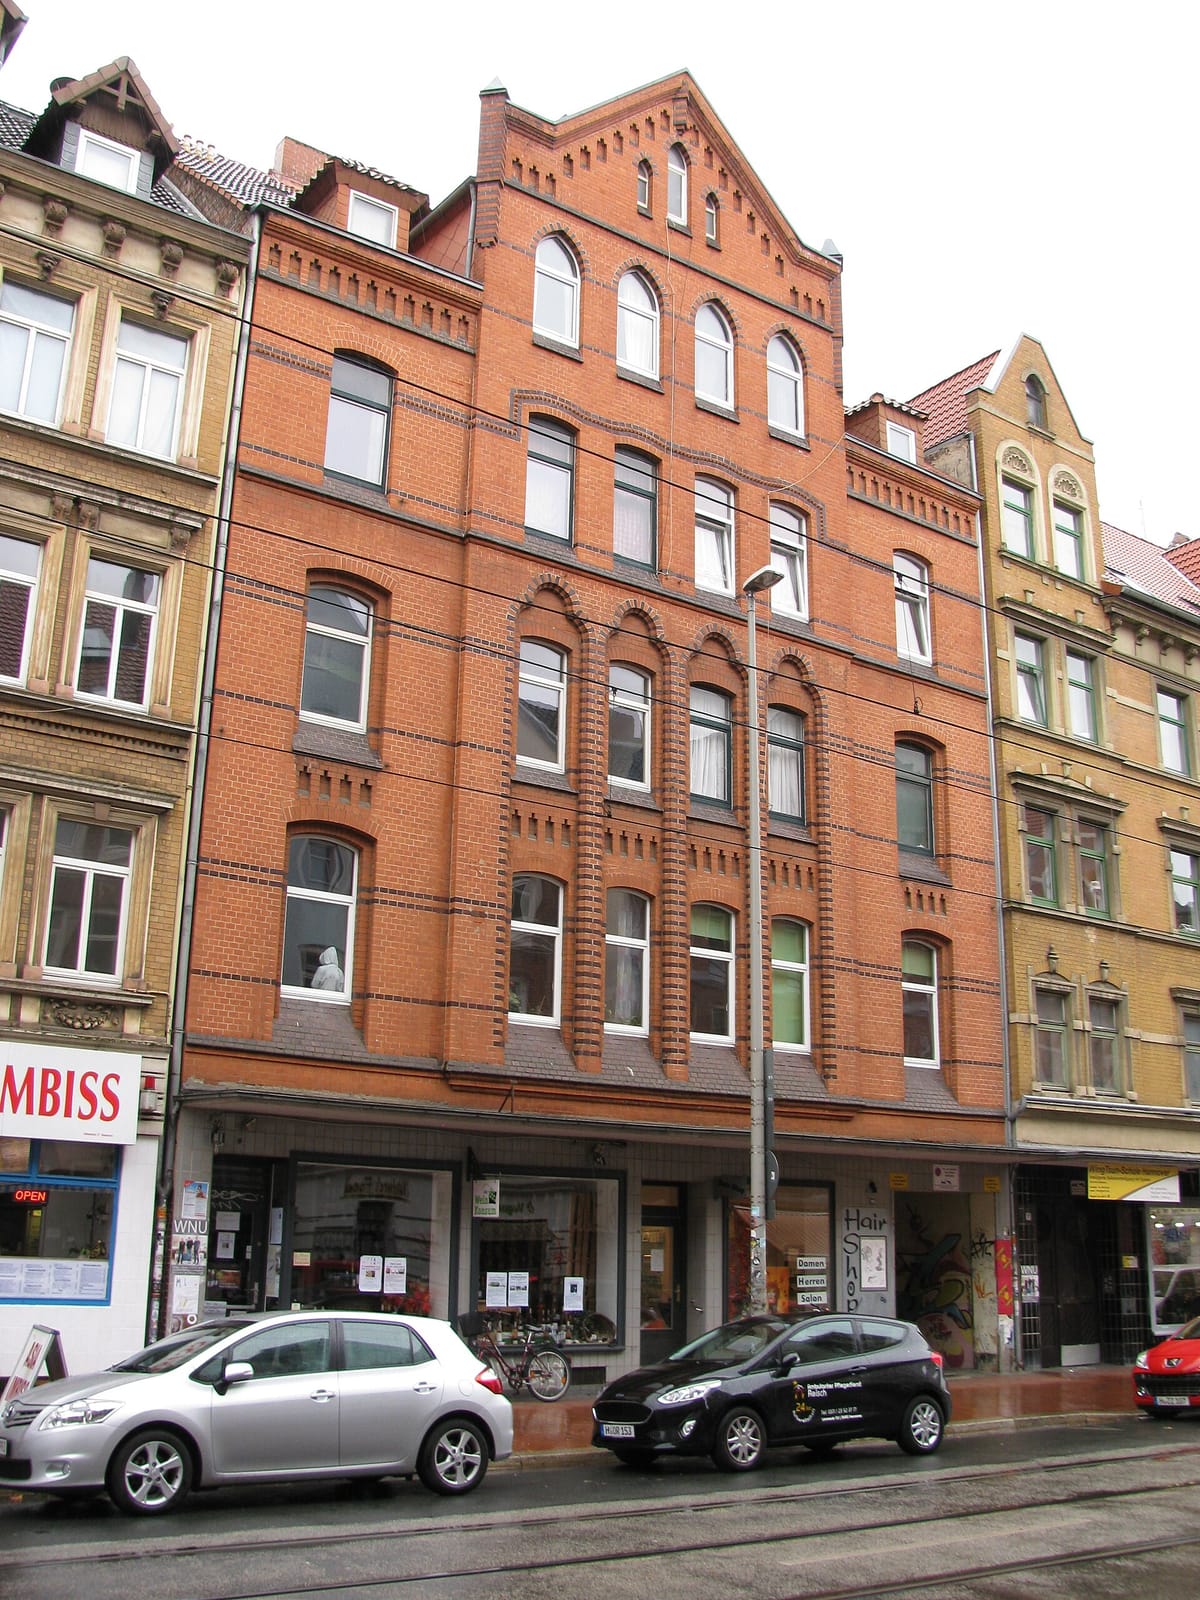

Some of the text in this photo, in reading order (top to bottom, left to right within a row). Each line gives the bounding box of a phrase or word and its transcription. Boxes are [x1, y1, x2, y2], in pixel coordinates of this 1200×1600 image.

[15, 1190, 47, 1201] OPEN
[844, 1209, 888, 1231] Hair
[174, 1220, 208, 1233] WNU
[798, 1259, 825, 1268] Damen
[843, 1233, 860, 1313] Shop
[798, 1277, 825, 1286] Herren
[801, 1294, 823, 1303] Salon
